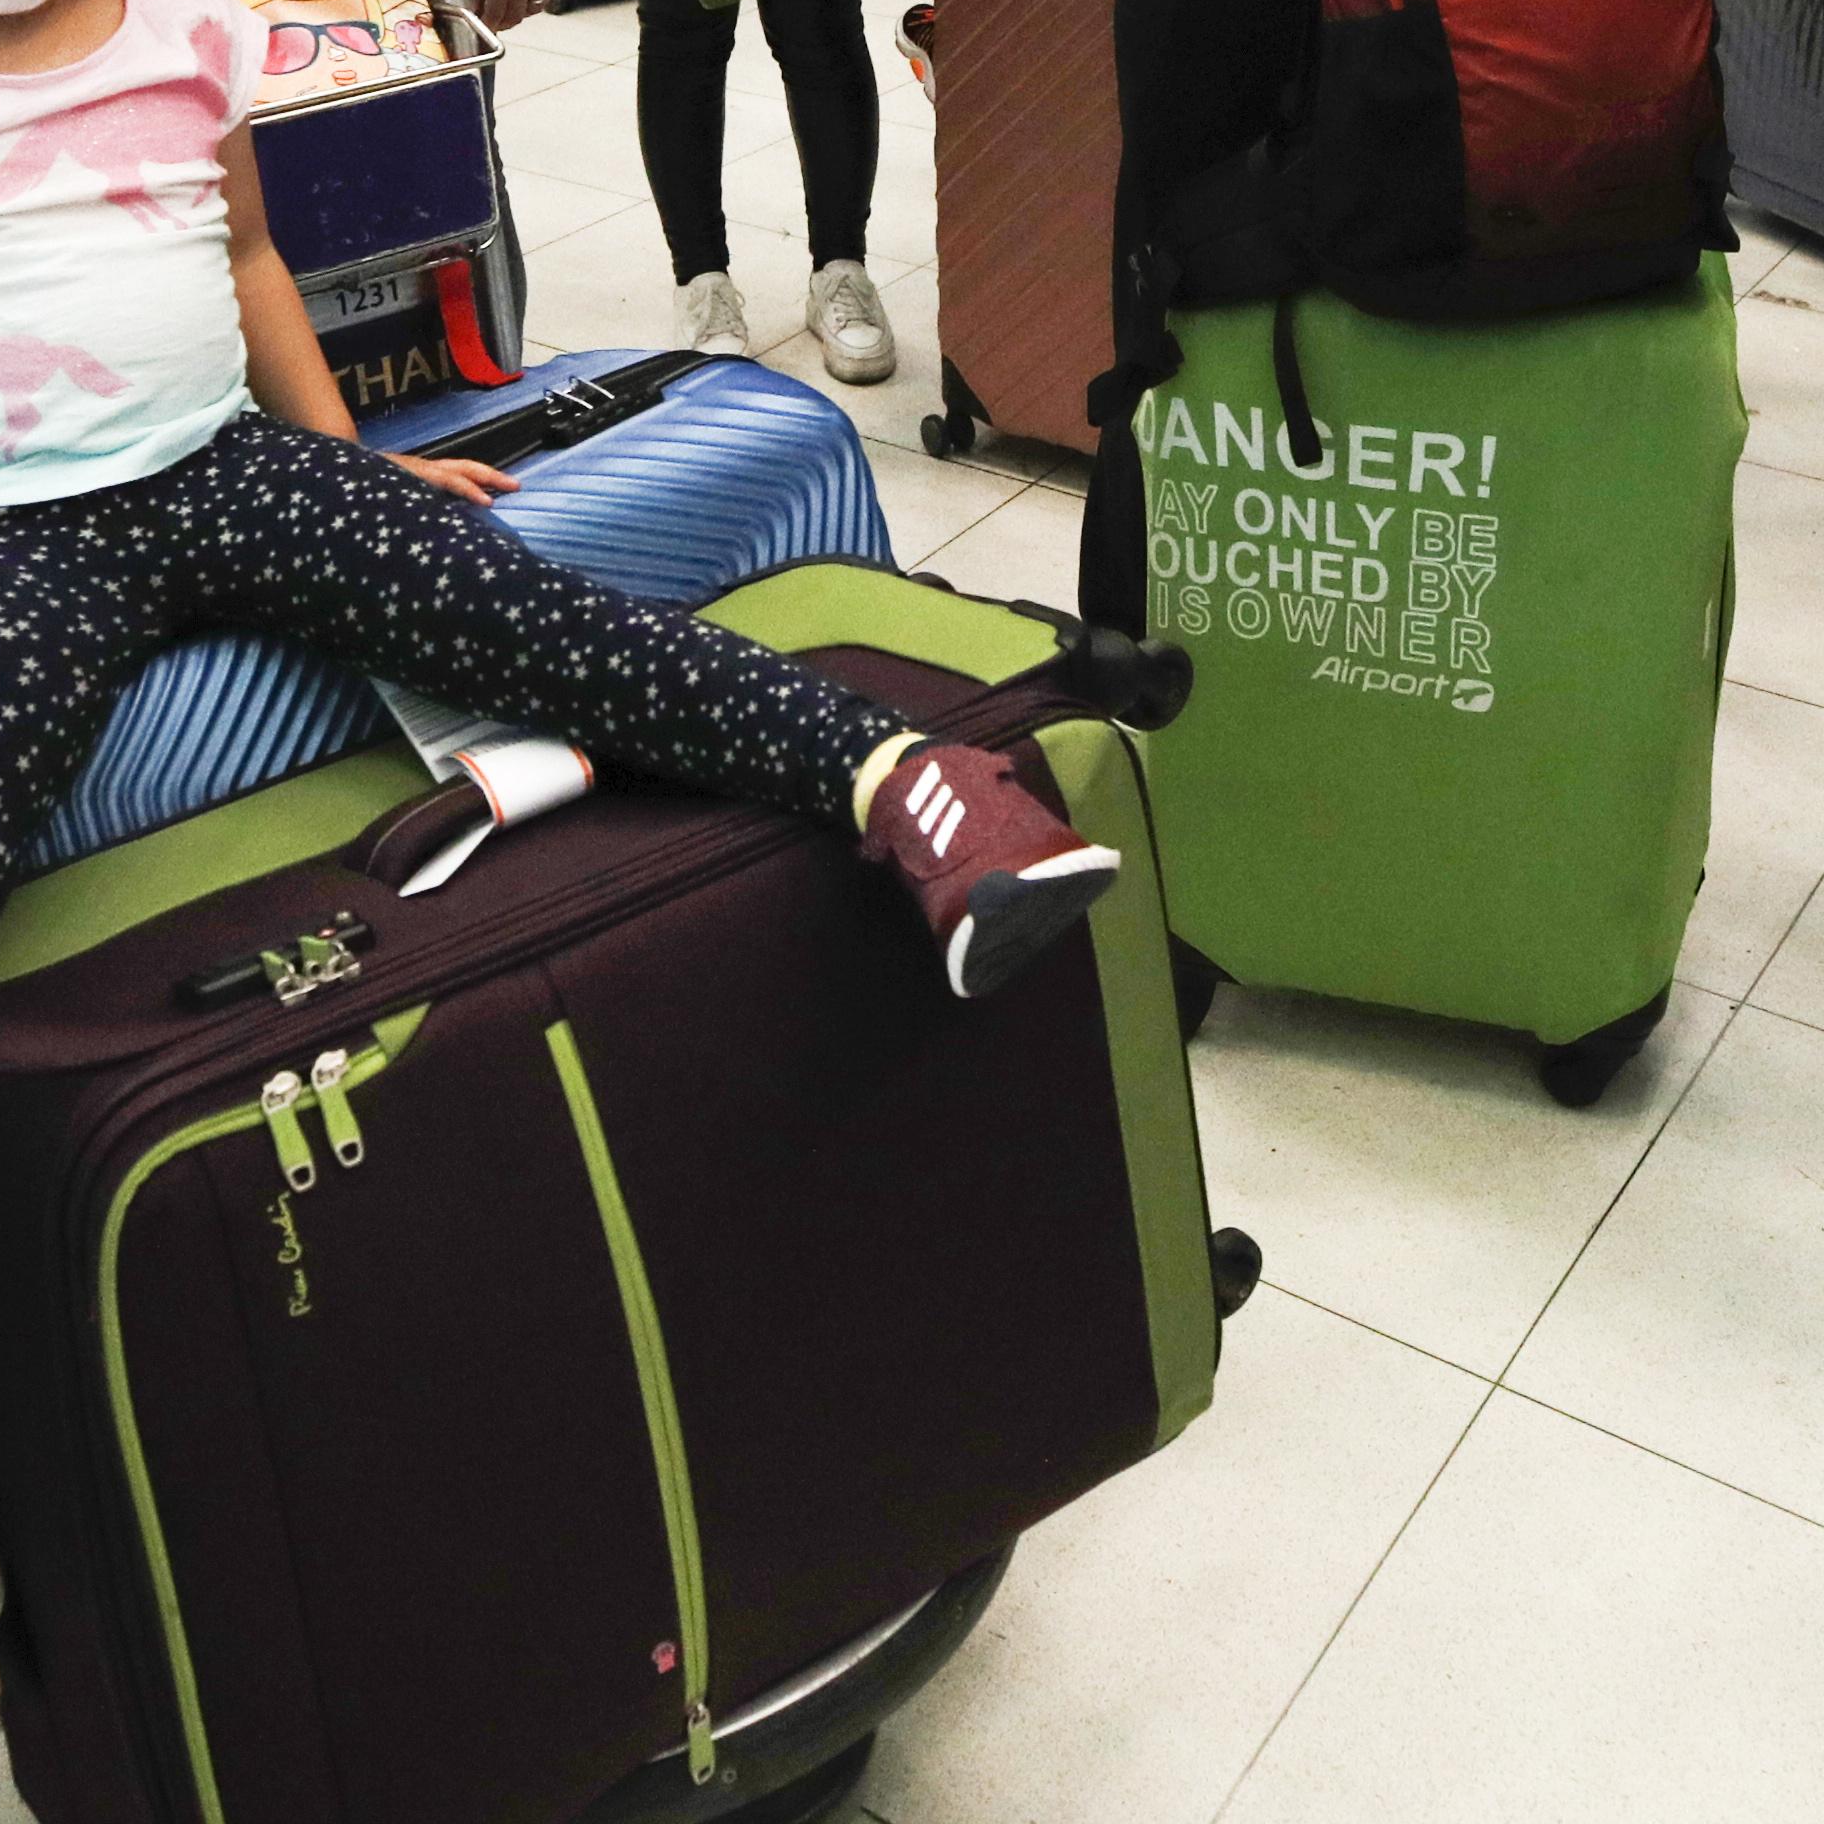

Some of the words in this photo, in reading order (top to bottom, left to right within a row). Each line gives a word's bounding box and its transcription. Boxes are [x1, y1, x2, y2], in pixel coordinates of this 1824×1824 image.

[335, 278, 399, 316] 1231
[1153, 478, 1219, 534] AY
[1233, 488, 1396, 551] ONLY
[1411, 508, 1499, 568] BE
[1149, 530, 1390, 604] OUCHED
[1408, 559, 1497, 620] BY
[1156, 580, 1212, 636] IS
[1226, 587, 1492, 674] OWNER
[1311, 655, 1450, 699] Airport
